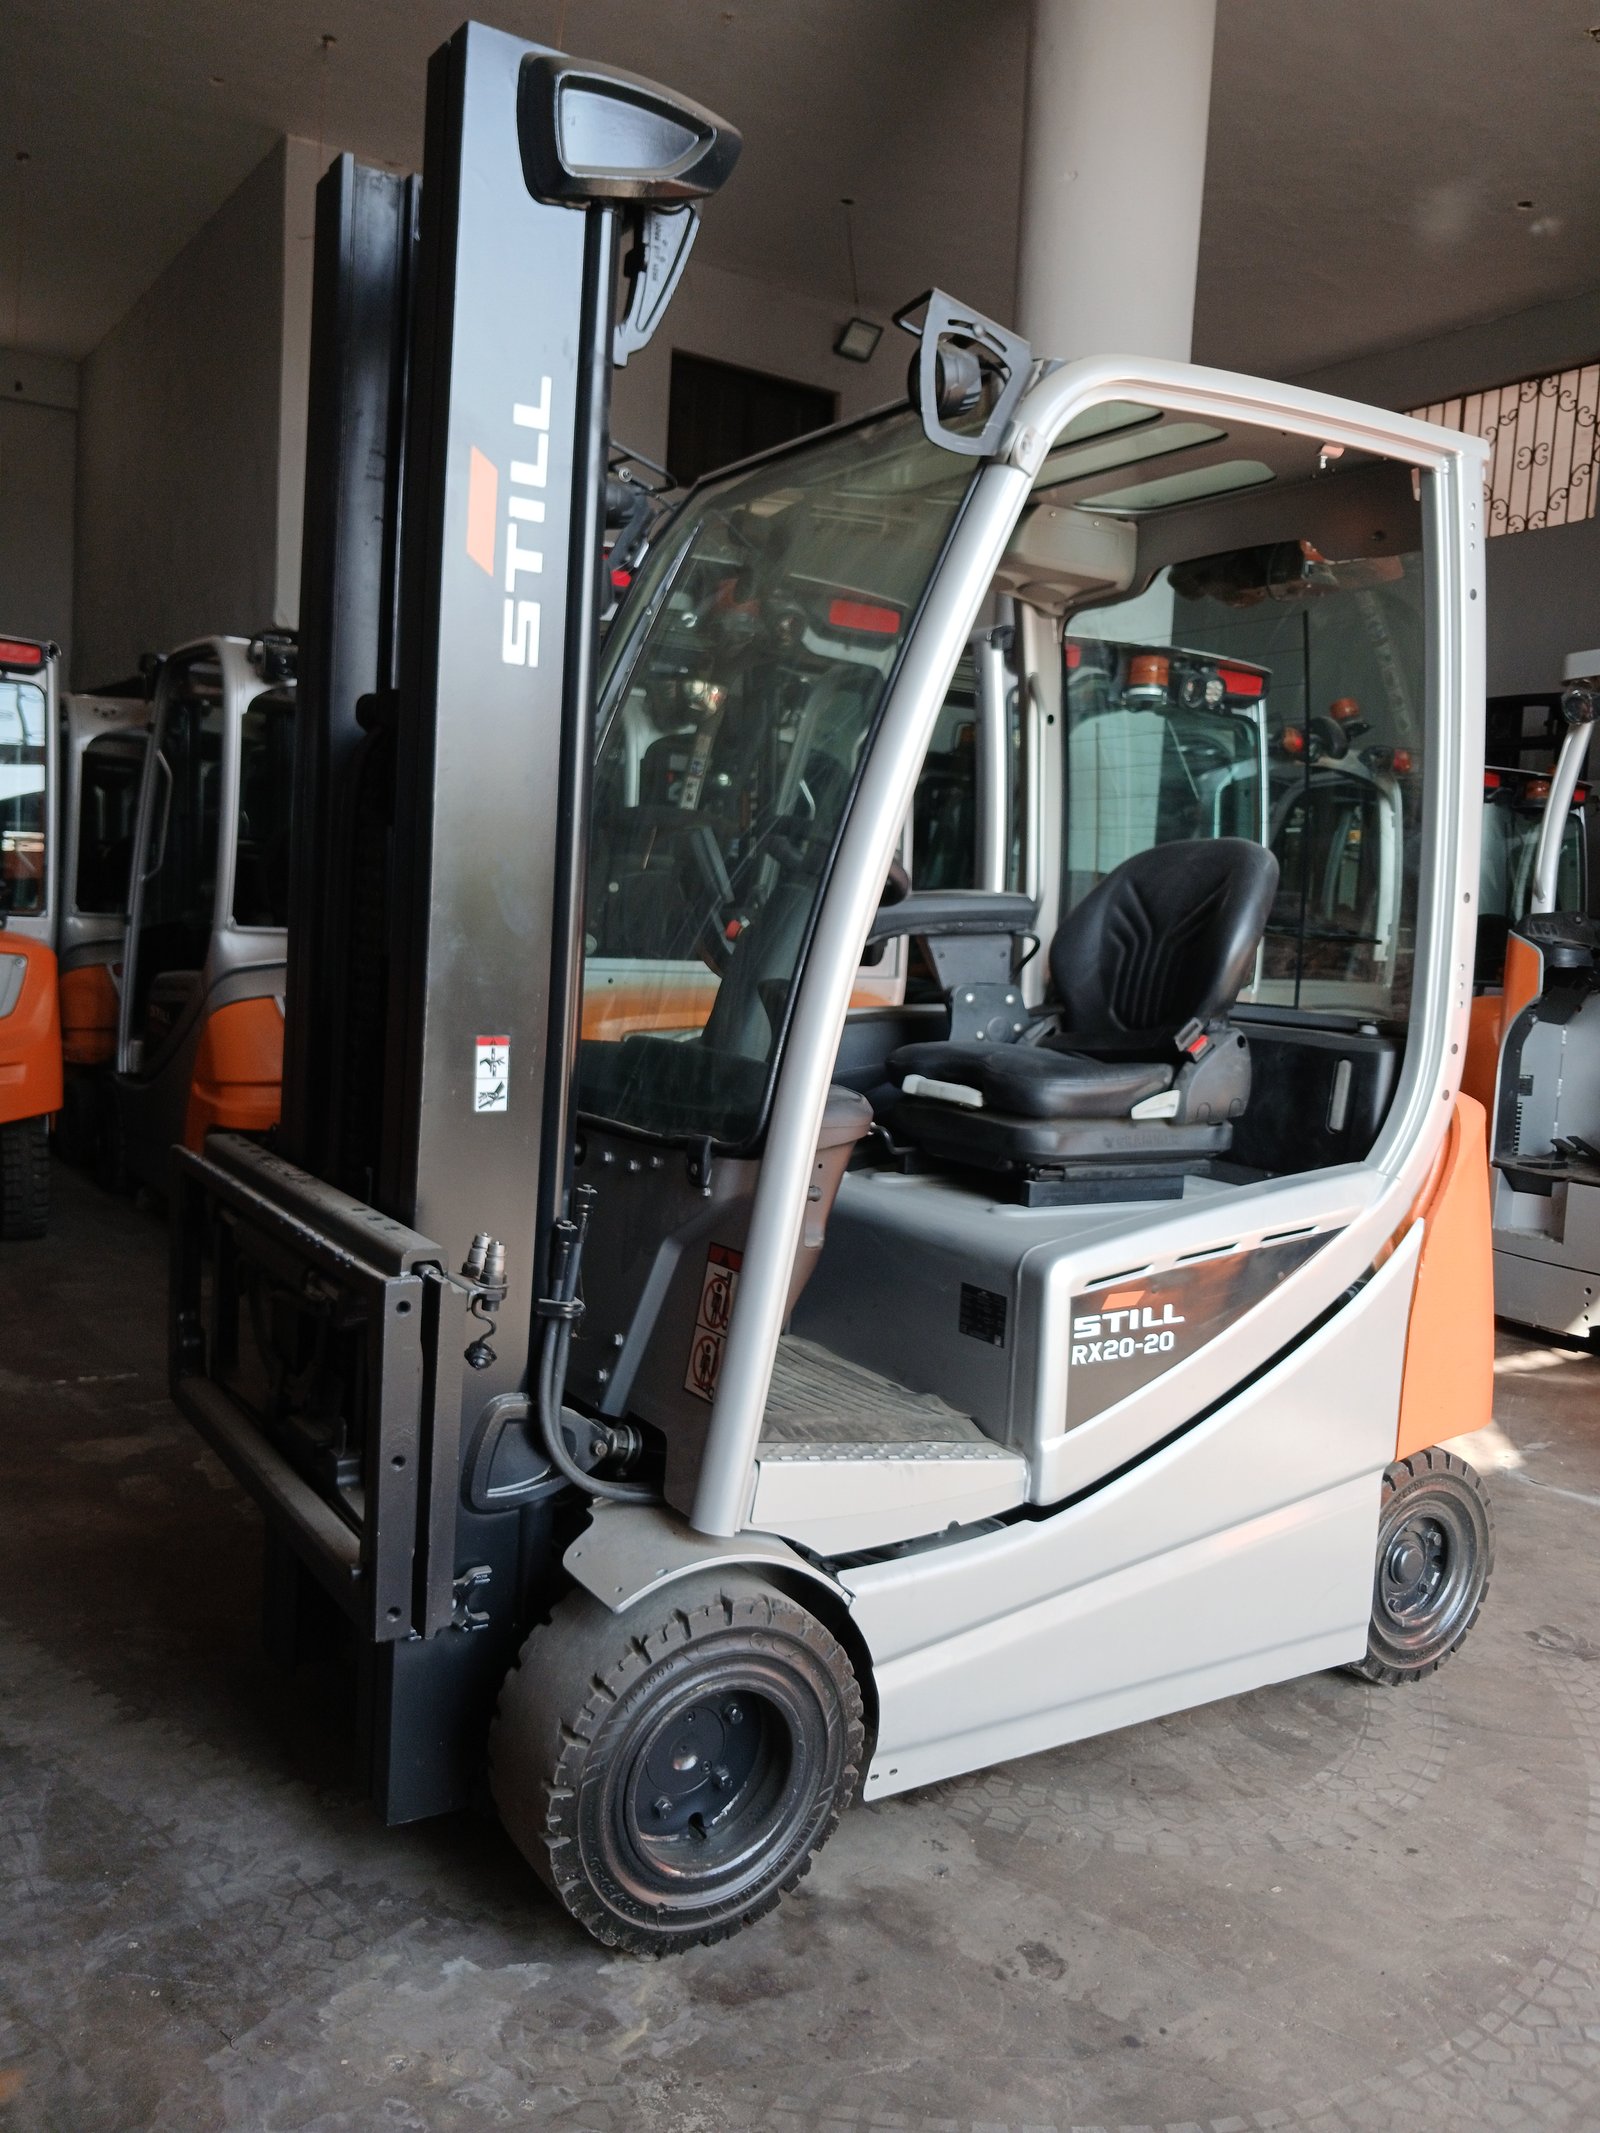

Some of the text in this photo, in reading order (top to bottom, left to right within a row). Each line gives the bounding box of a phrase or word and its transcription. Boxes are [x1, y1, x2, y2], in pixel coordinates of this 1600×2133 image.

[502, 376, 552, 668] STILL
[1073, 1303, 1185, 1339] STILL
[1071, 1330, 1175, 1365] RX20-20
